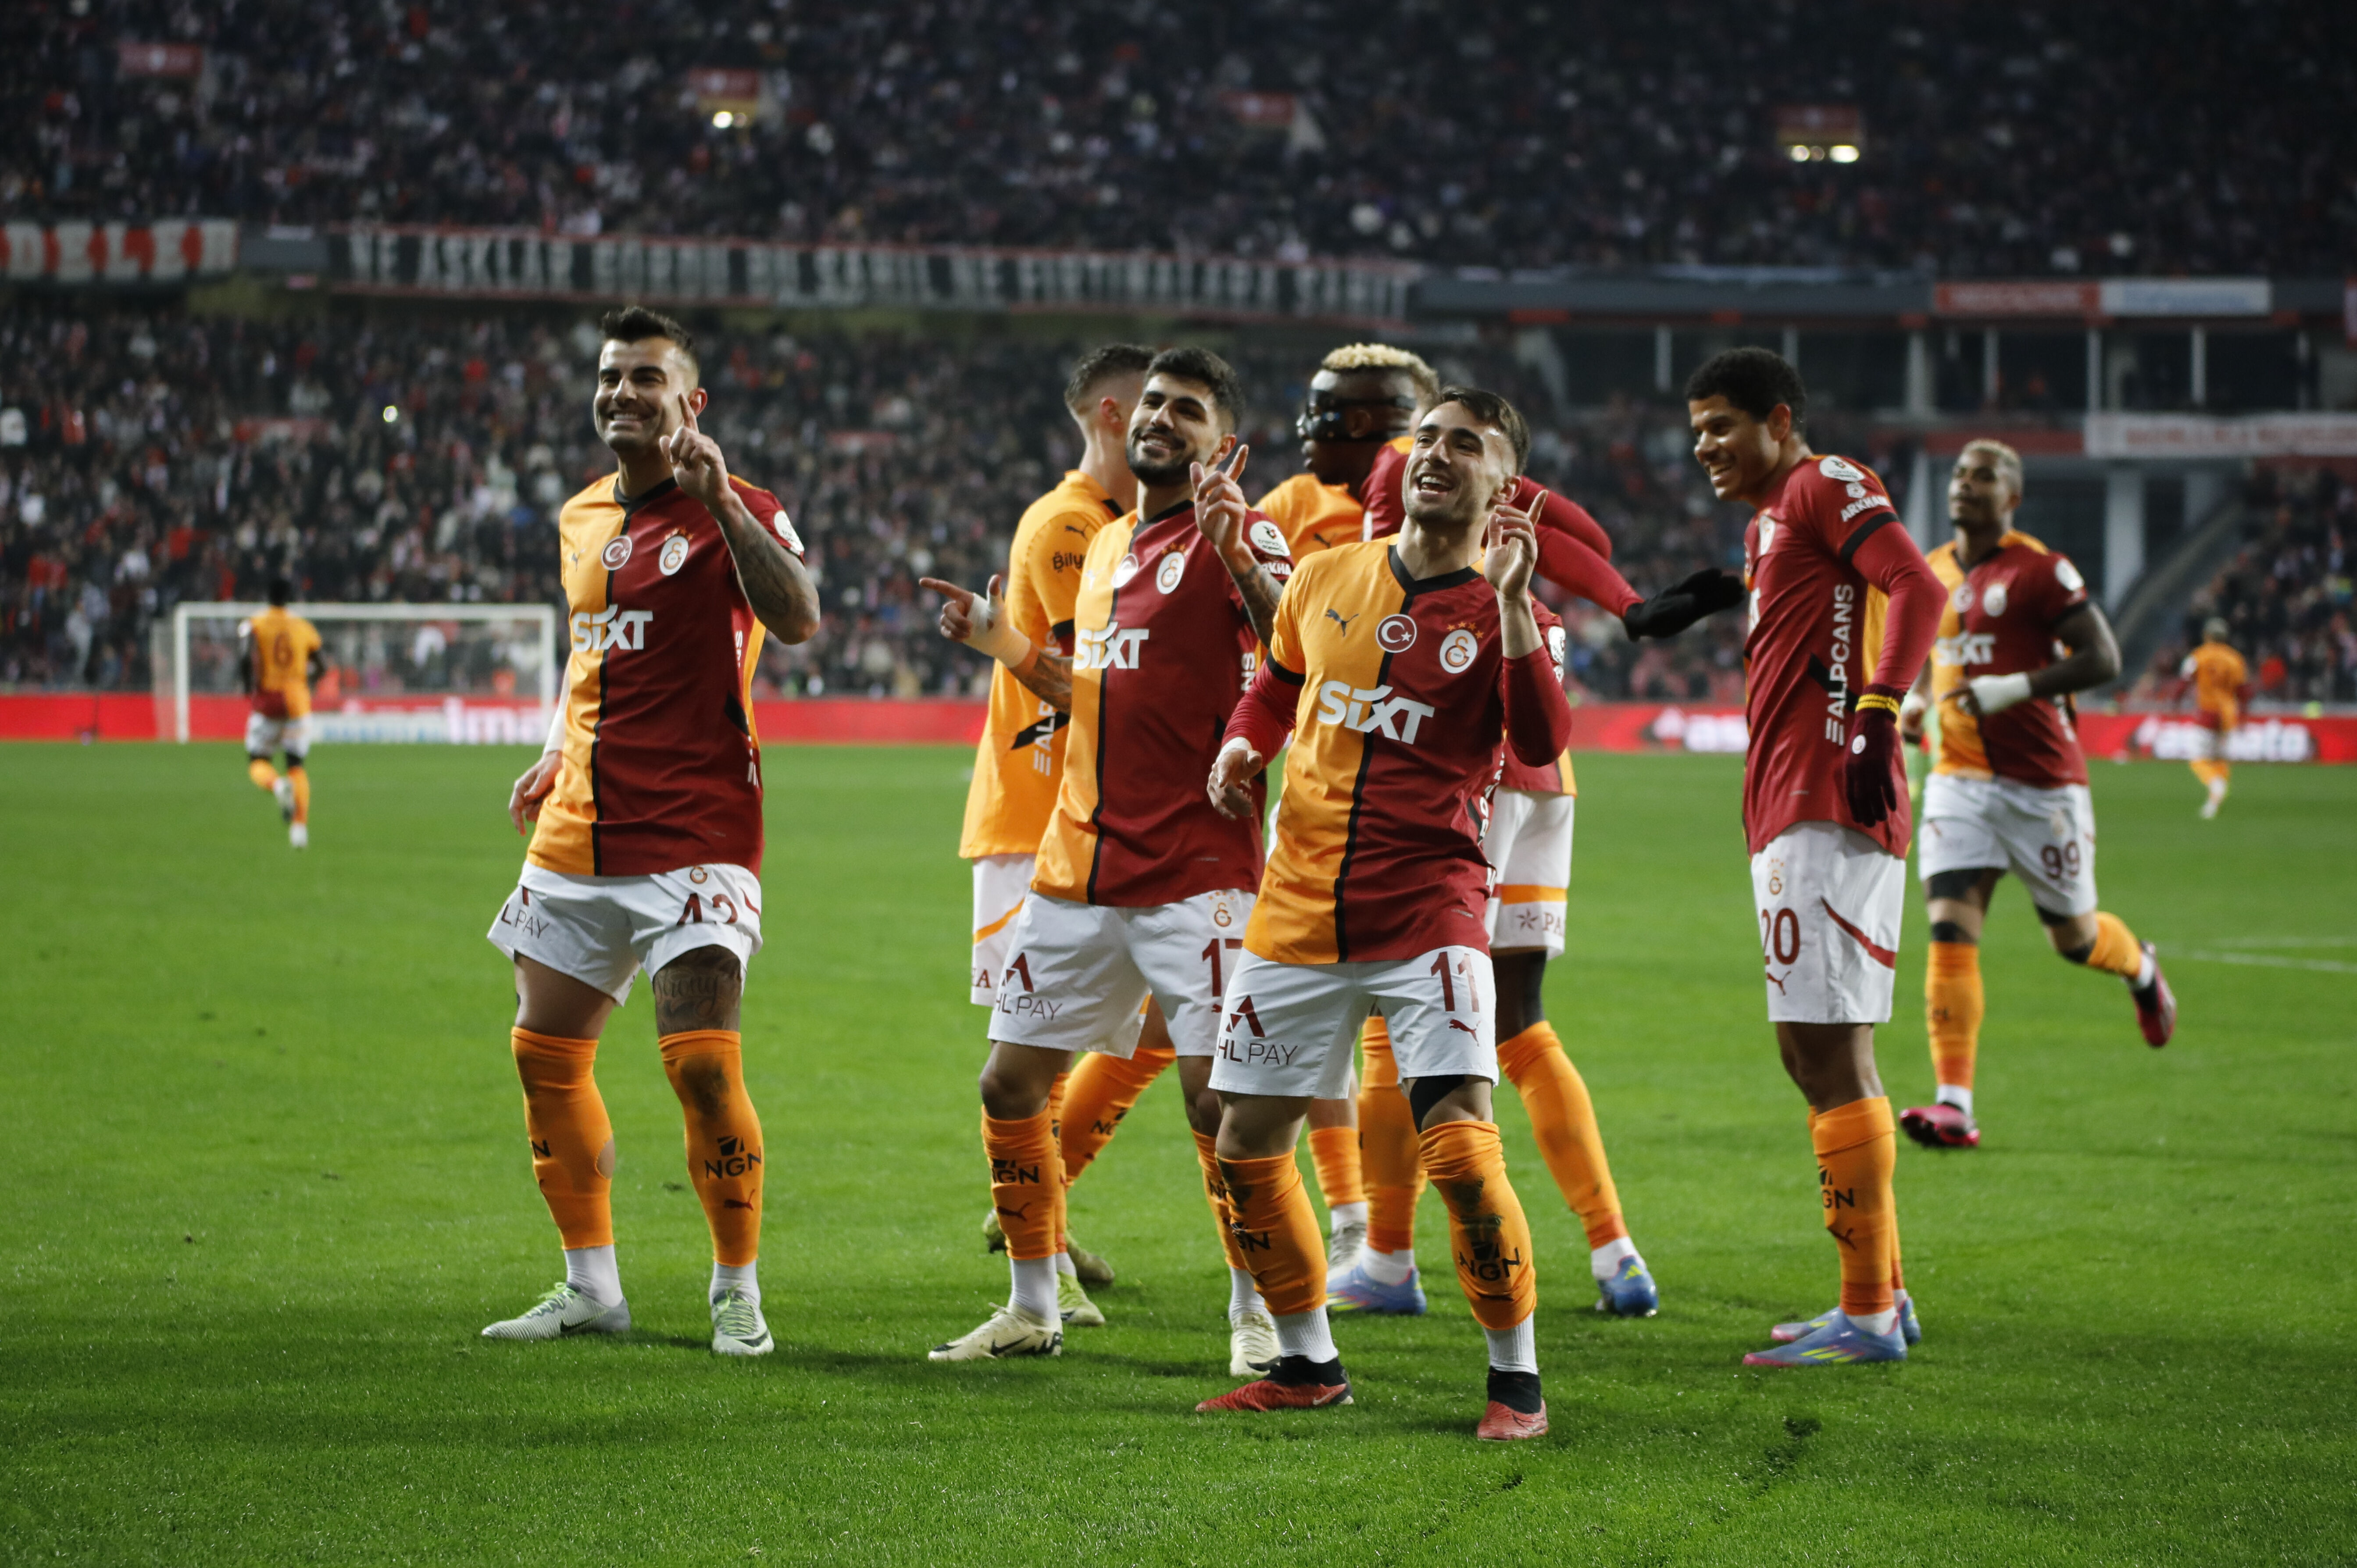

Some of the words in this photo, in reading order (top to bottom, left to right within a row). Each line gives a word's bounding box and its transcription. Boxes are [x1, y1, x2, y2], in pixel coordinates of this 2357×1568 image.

[1827, 584, 1854, 718] ALPCANS
[1317, 681, 1435, 745] SIXT
[2041, 841, 2080, 880] 99
[515, 909, 550, 939] PAY
[1761, 907, 1800, 965] 20
[1431, 952, 1480, 1012] 11
[1016, 997, 1063, 1020] PAY
[1248, 1043, 1298, 1065] PAY
[704, 1145, 761, 1179] NGN
[1458, 1247, 1521, 1281] NGN
